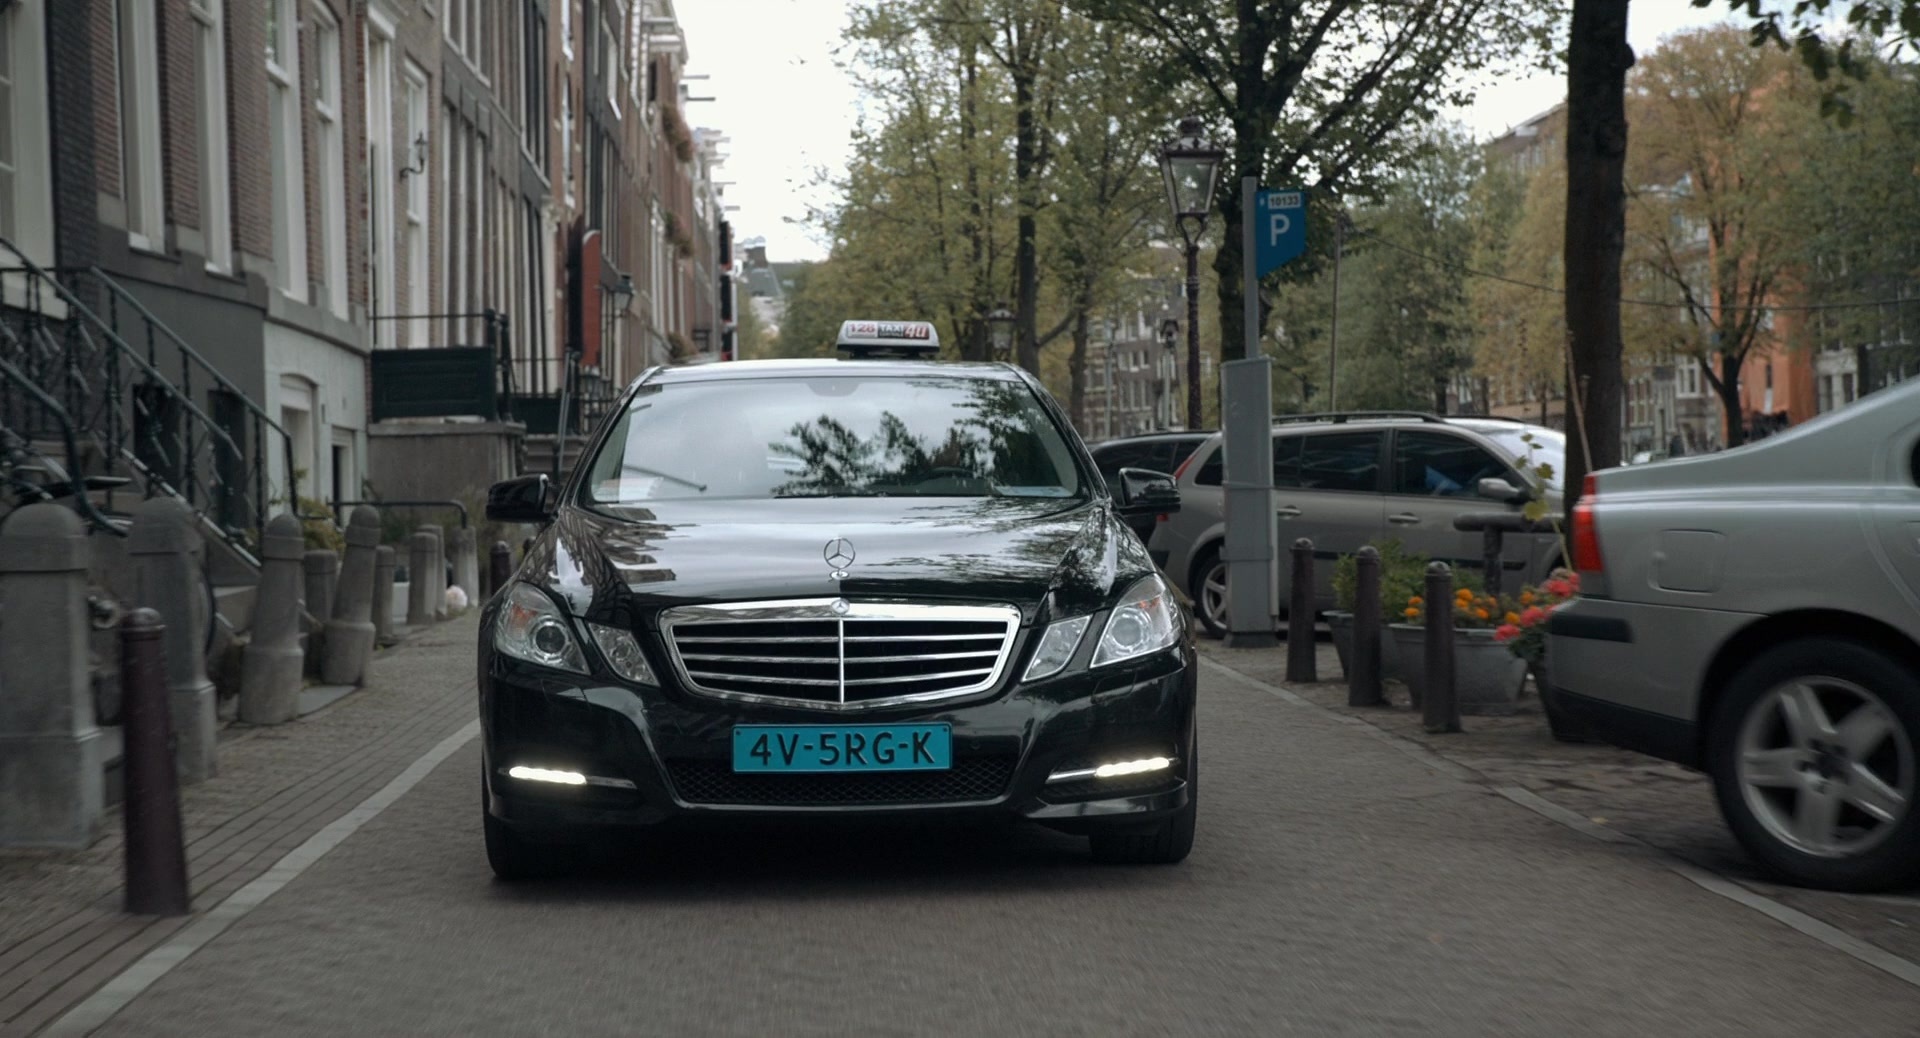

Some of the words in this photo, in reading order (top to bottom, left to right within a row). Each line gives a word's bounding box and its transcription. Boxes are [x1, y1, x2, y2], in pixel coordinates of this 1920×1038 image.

[1270, 195, 1299, 207] 10133
[1270, 213, 1291, 247] P
[749, 731, 936, 766] 4V-5RG-K
